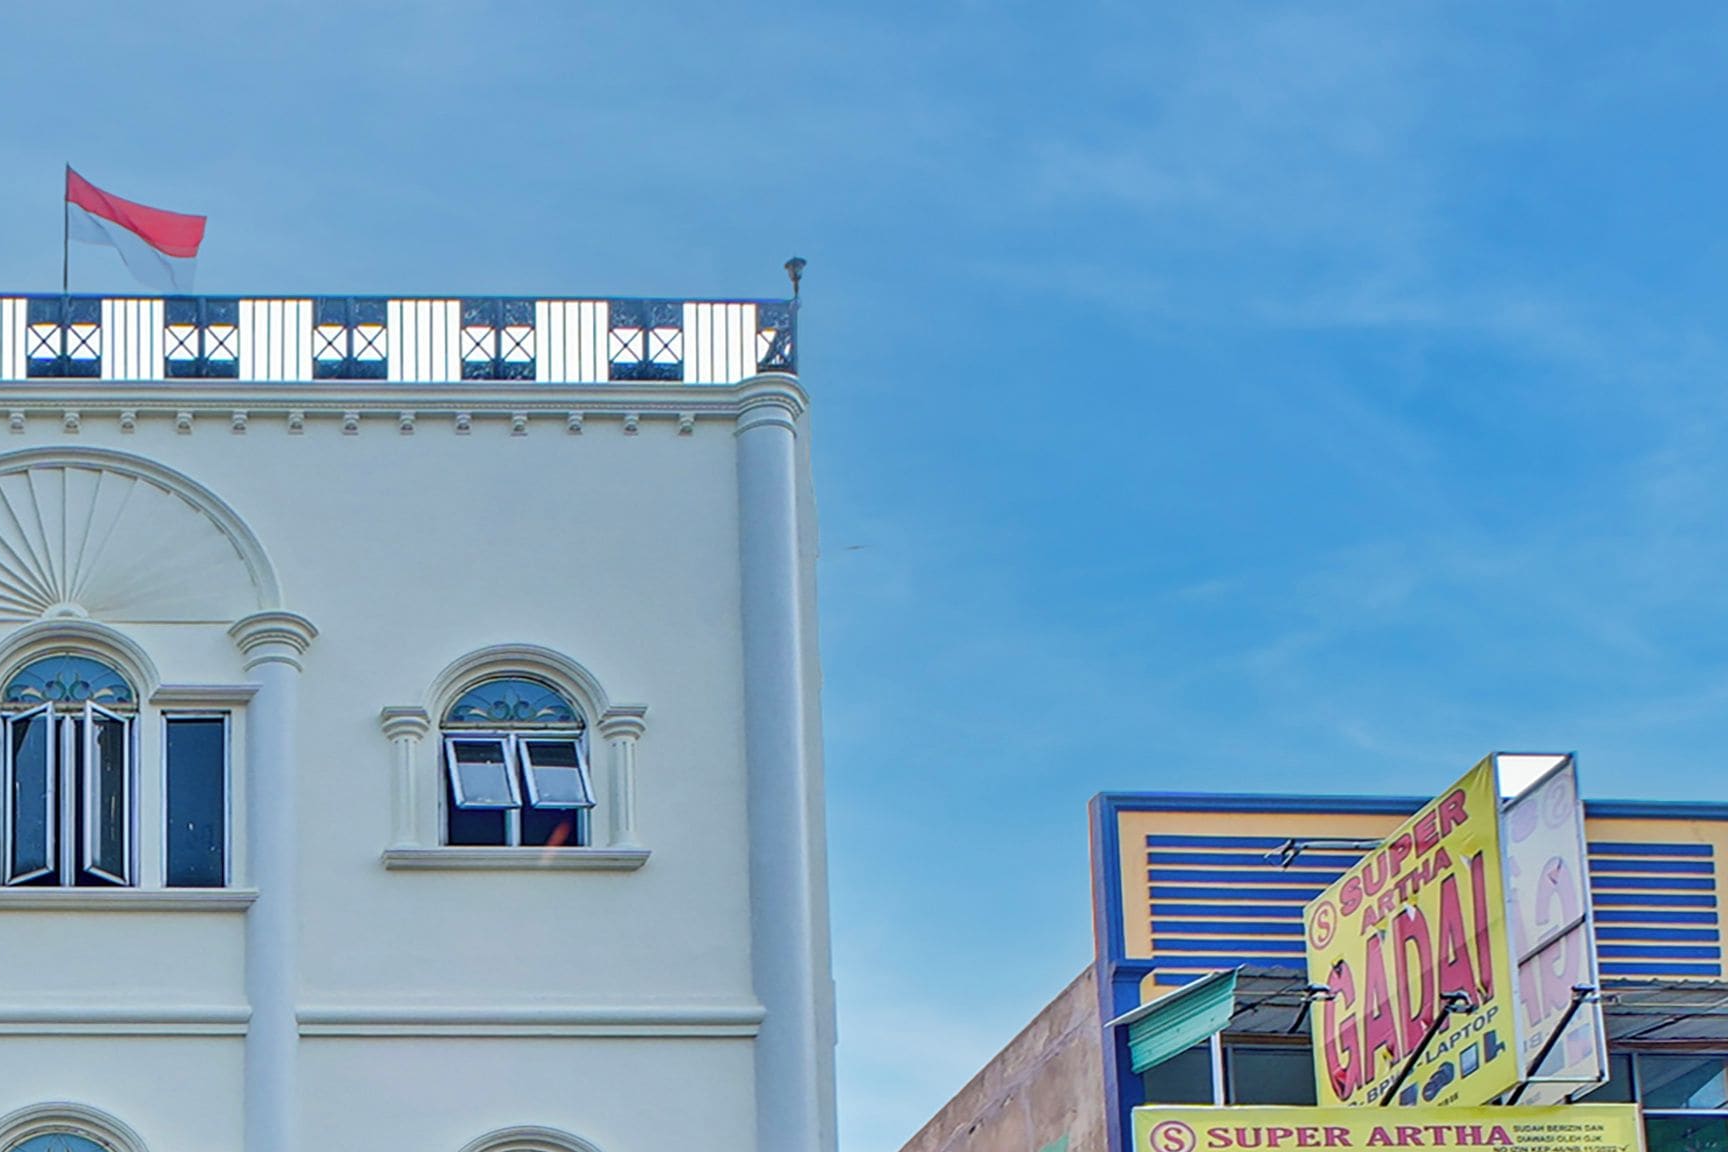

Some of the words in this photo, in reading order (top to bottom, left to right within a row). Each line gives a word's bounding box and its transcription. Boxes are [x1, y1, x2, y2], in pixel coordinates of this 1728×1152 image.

[1339, 788, 1469, 917] SUPER
[1360, 846, 1453, 937] ARTHA
[1324, 850, 1494, 1102] GADAI
[1206, 1126, 1353, 1149] SUPER
[1365, 1125, 1514, 1147] ARTHA
